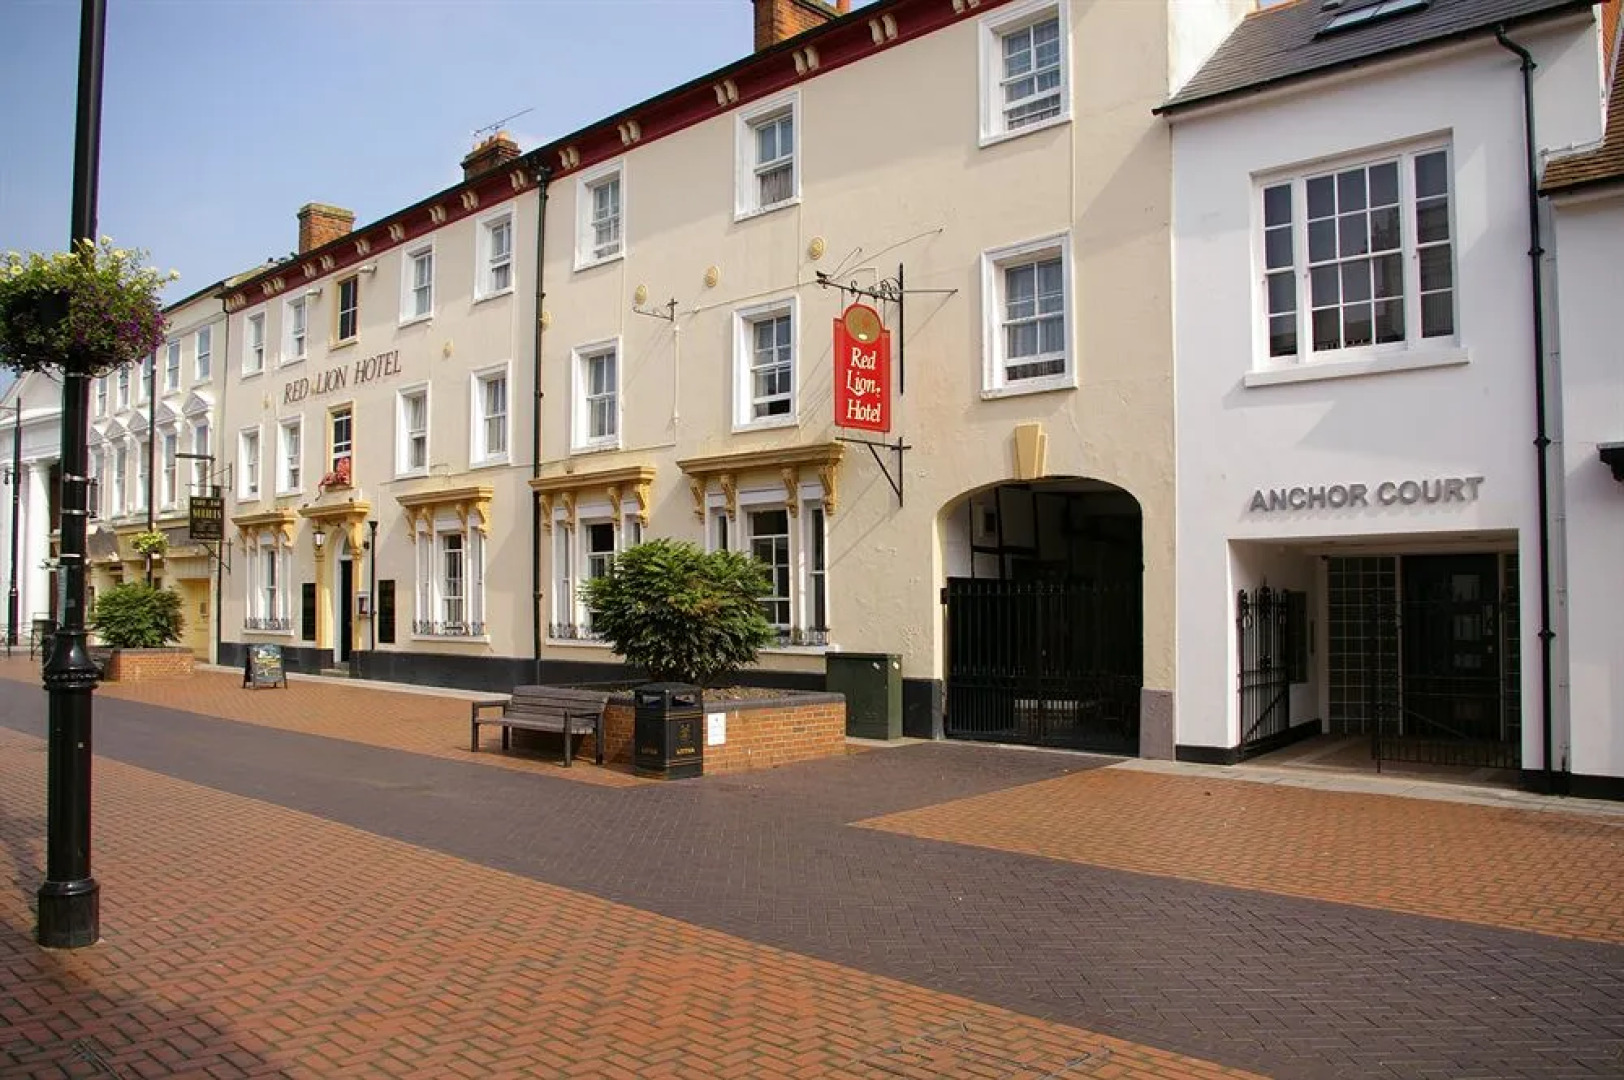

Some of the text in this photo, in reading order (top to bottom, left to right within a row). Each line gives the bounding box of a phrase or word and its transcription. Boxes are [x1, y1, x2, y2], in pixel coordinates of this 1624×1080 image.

[850, 346, 877, 370] Red
[283, 350, 402, 404] RED LION HOTEL
[846, 398, 881, 422] Hotel
[1249, 476, 1485, 512] ANCHOR COURT
